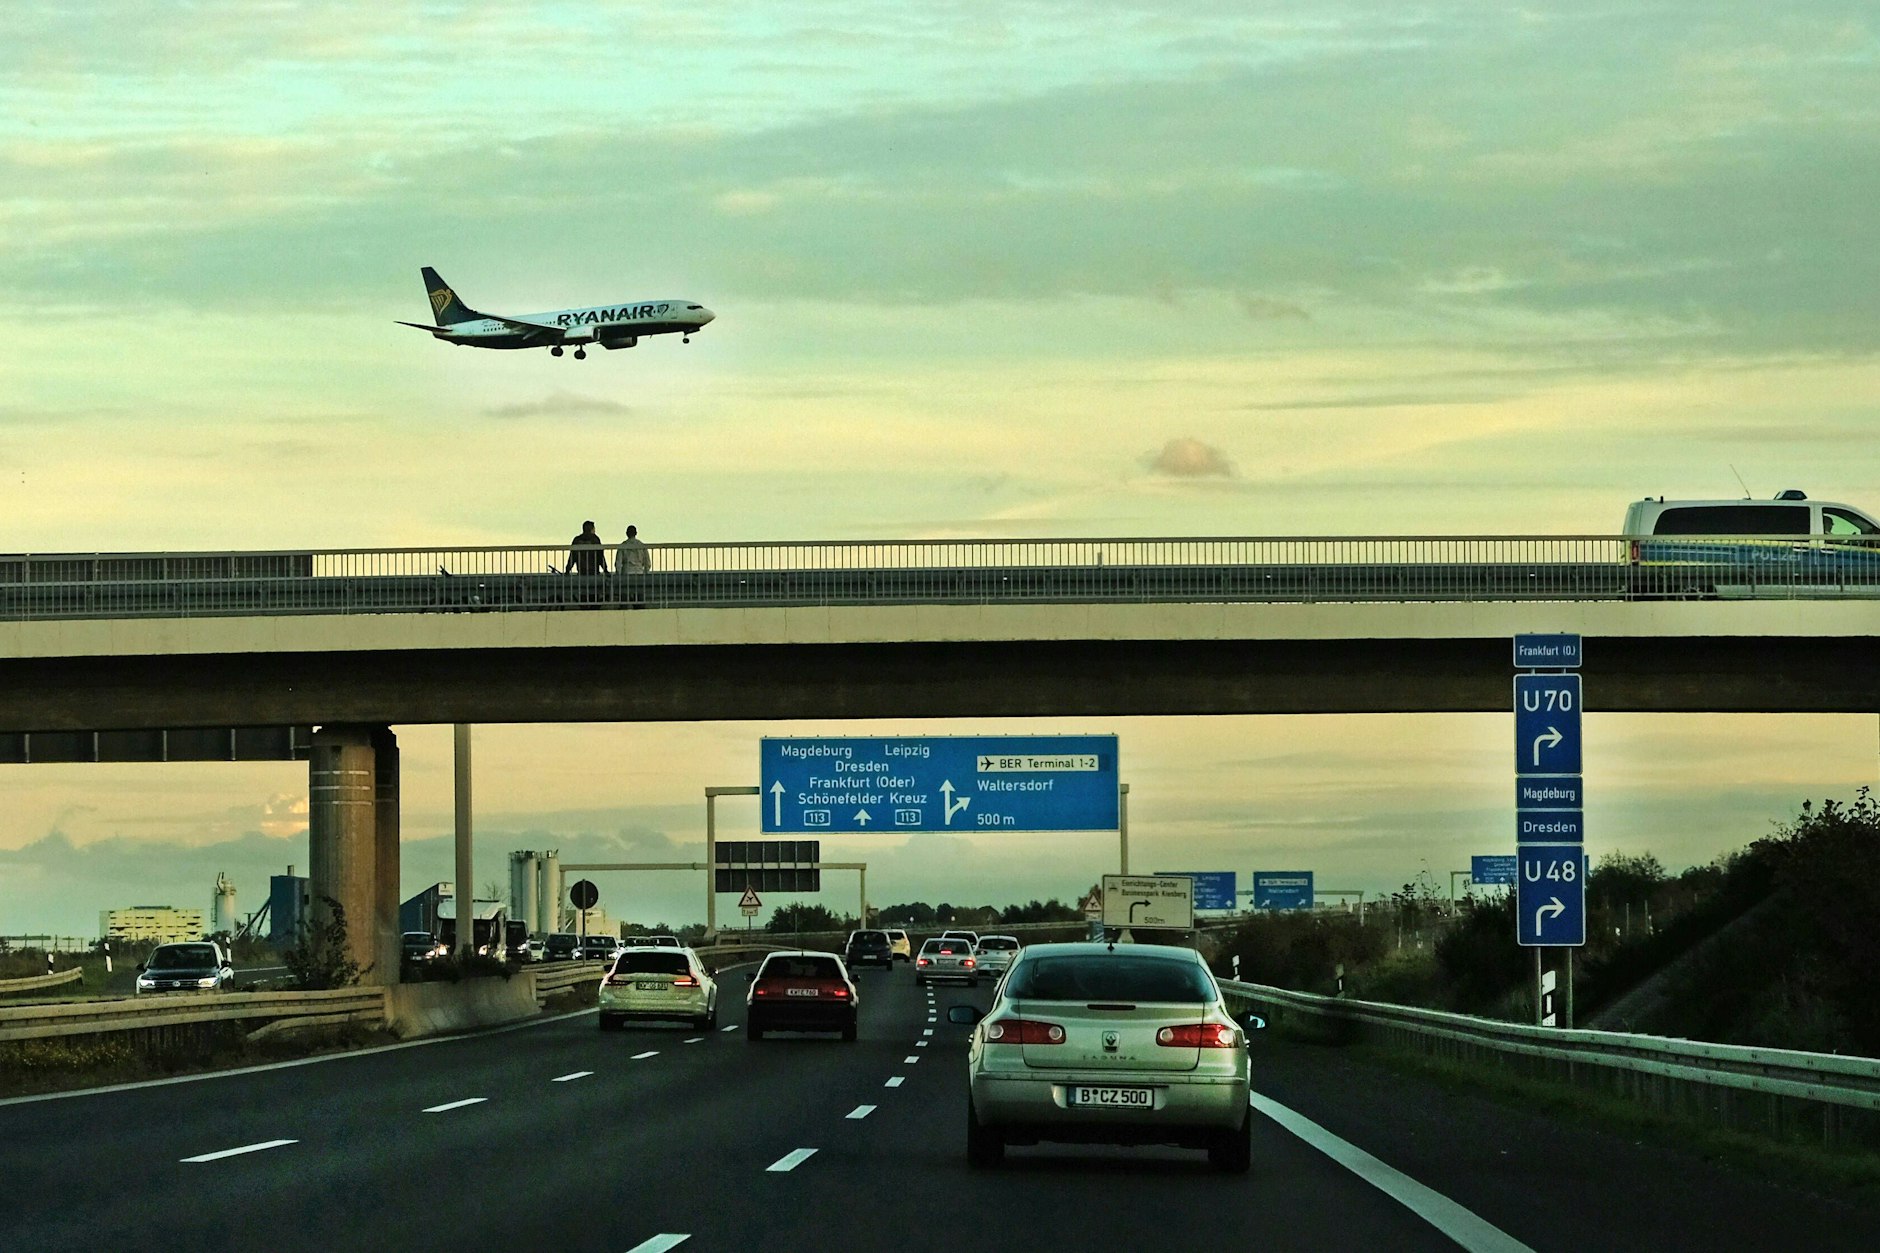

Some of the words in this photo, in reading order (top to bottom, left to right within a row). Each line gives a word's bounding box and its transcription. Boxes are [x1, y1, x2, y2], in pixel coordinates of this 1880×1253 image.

[557, 305, 654, 326] RYANAIR
[1519, 645, 1559, 656] Frankfurt
[1523, 690, 1539, 712] U
[1544, 690, 1572, 712] 70
[781, 745, 853, 759] Magdeburg
[885, 744, 930, 759] Leipzig
[835, 760, 889, 772] Dresden
[1000, 758, 1022, 769] BER
[1028, 757, 1075, 768] Terminal
[1080, 758, 1096, 768] 1-2
[809, 776, 870, 789] Frankfurt
[876, 775, 915, 788] (Oder)
[977, 779, 1054, 792] Waltersdorf
[798, 792, 883, 805] Schönefelder
[890, 792, 927, 804] Kreuz
[1523, 787, 1576, 802] Magdeburg
[809, 813, 825, 823] 113
[900, 812, 916, 822] 113
[977, 813, 1000, 825] 500
[1003, 816, 1015, 825] m
[1523, 821, 1577, 833] Dresden
[1525, 860, 1541, 882] U
[1546, 860, 1576, 882] 48
[1081, 1089, 1091, 1102] B
[1100, 1089, 1119, 1103] CZ
[1121, 1090, 1147, 1104] 500
